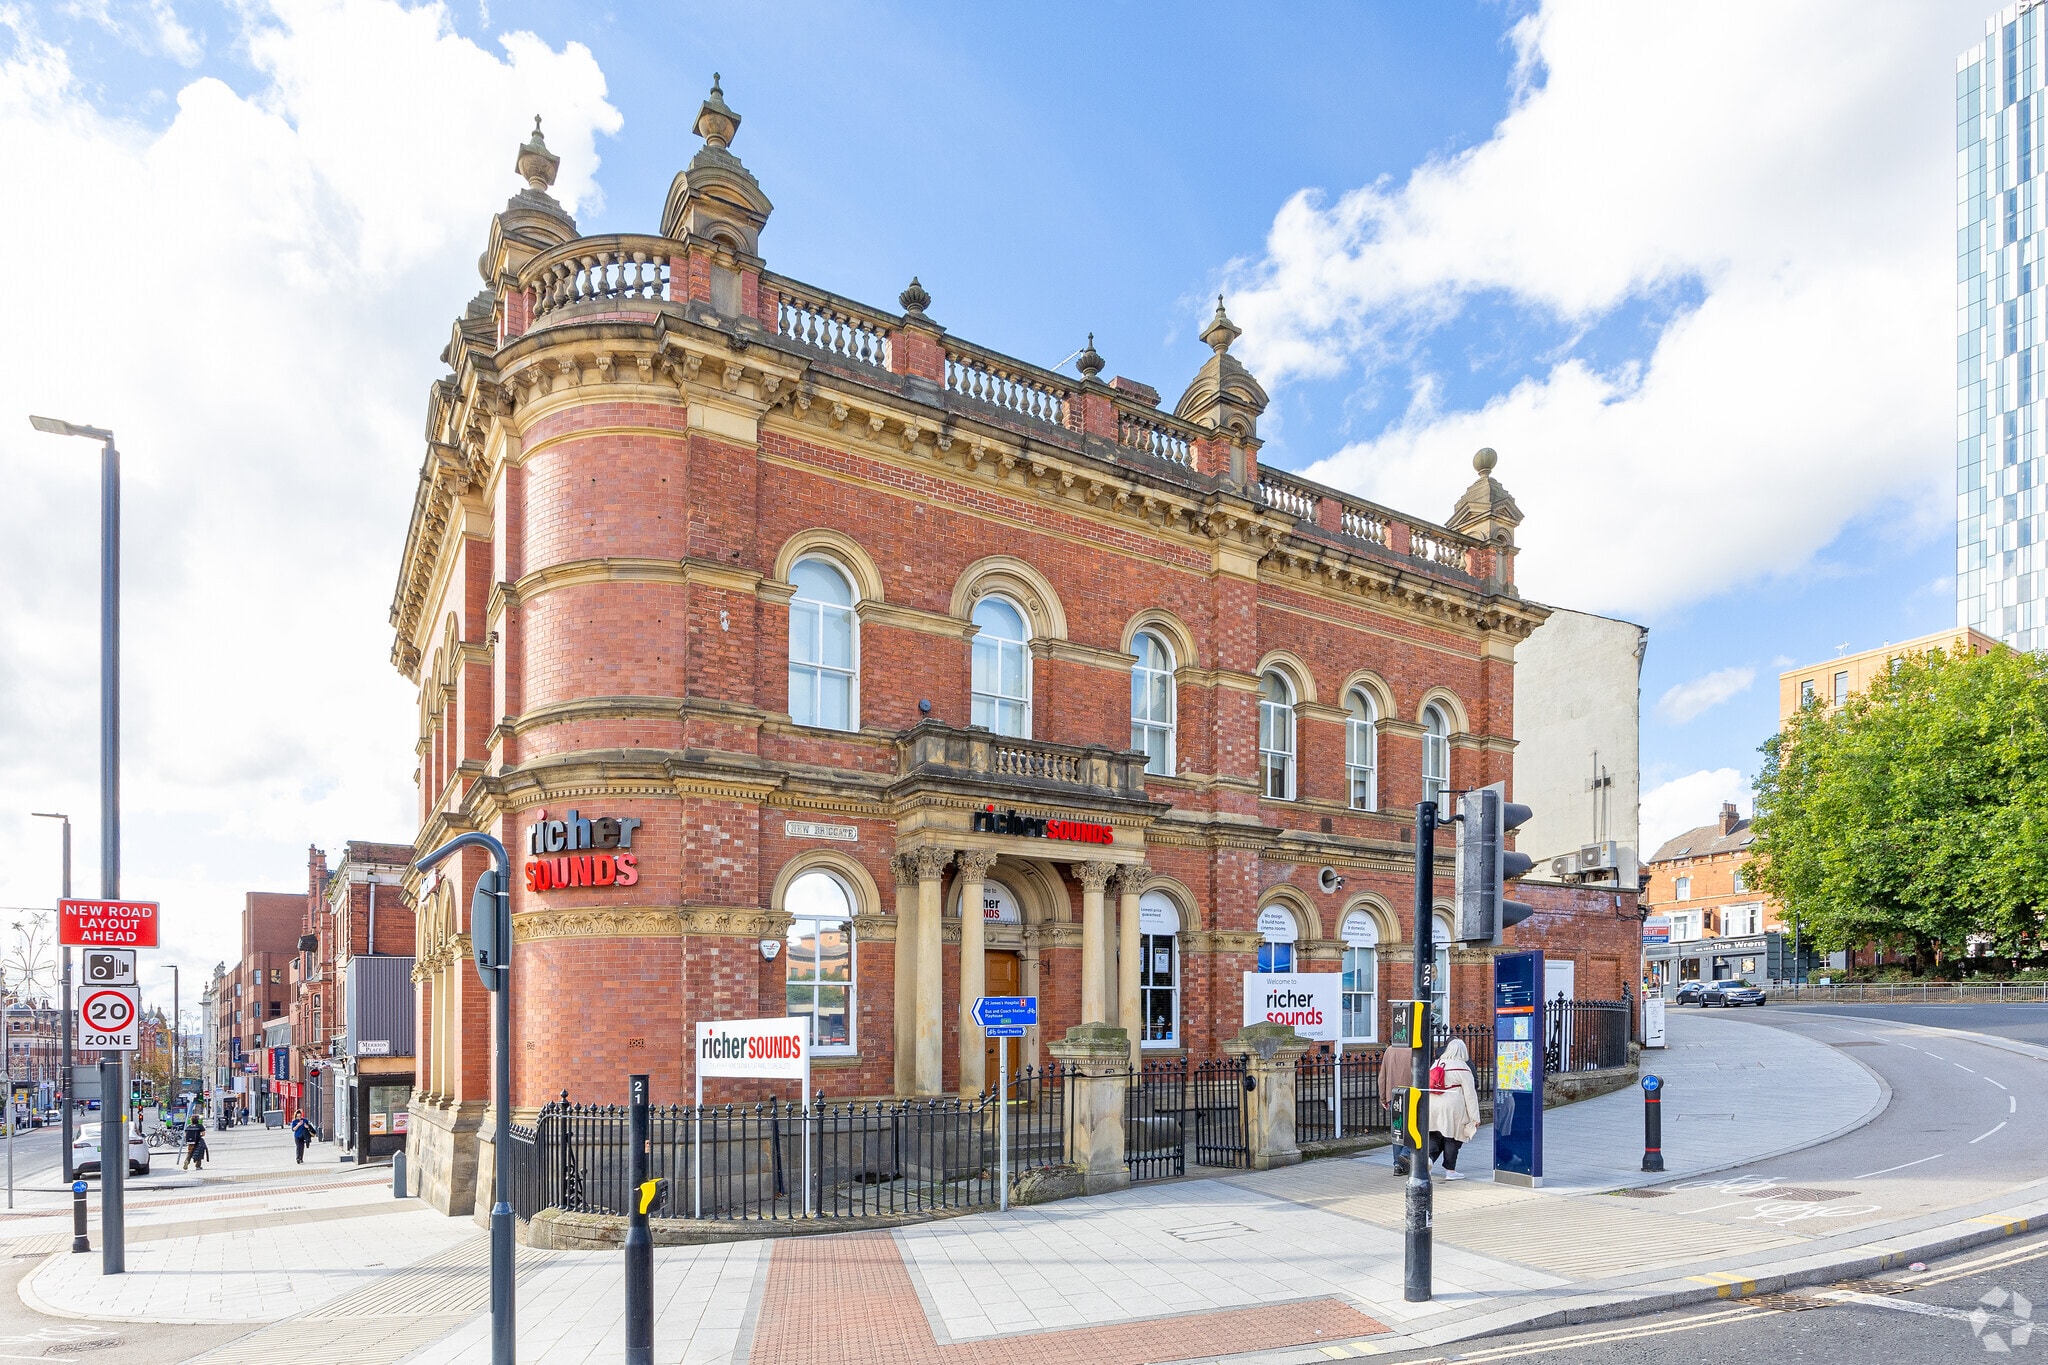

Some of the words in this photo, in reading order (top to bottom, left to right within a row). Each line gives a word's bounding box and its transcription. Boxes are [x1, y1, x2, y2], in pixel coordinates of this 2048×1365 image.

[526, 808, 641, 856] richer
[791, 823, 809, 834] NEW
[814, 826, 854, 838] BRIGGATE
[525, 853, 639, 892] SOUNDS
[65, 904, 103, 916] NEW
[108, 906, 153, 918] ROAD
[79, 917, 140, 930] LAYOUT
[81, 930, 137, 942] AHEAD
[1734, 940, 1766, 948] Wrens
[1266, 989, 1314, 1008] richer
[91, 1003, 127, 1020] 20
[1266, 1007, 1323, 1026] sounds
[85, 1034, 132, 1046] ZONE
